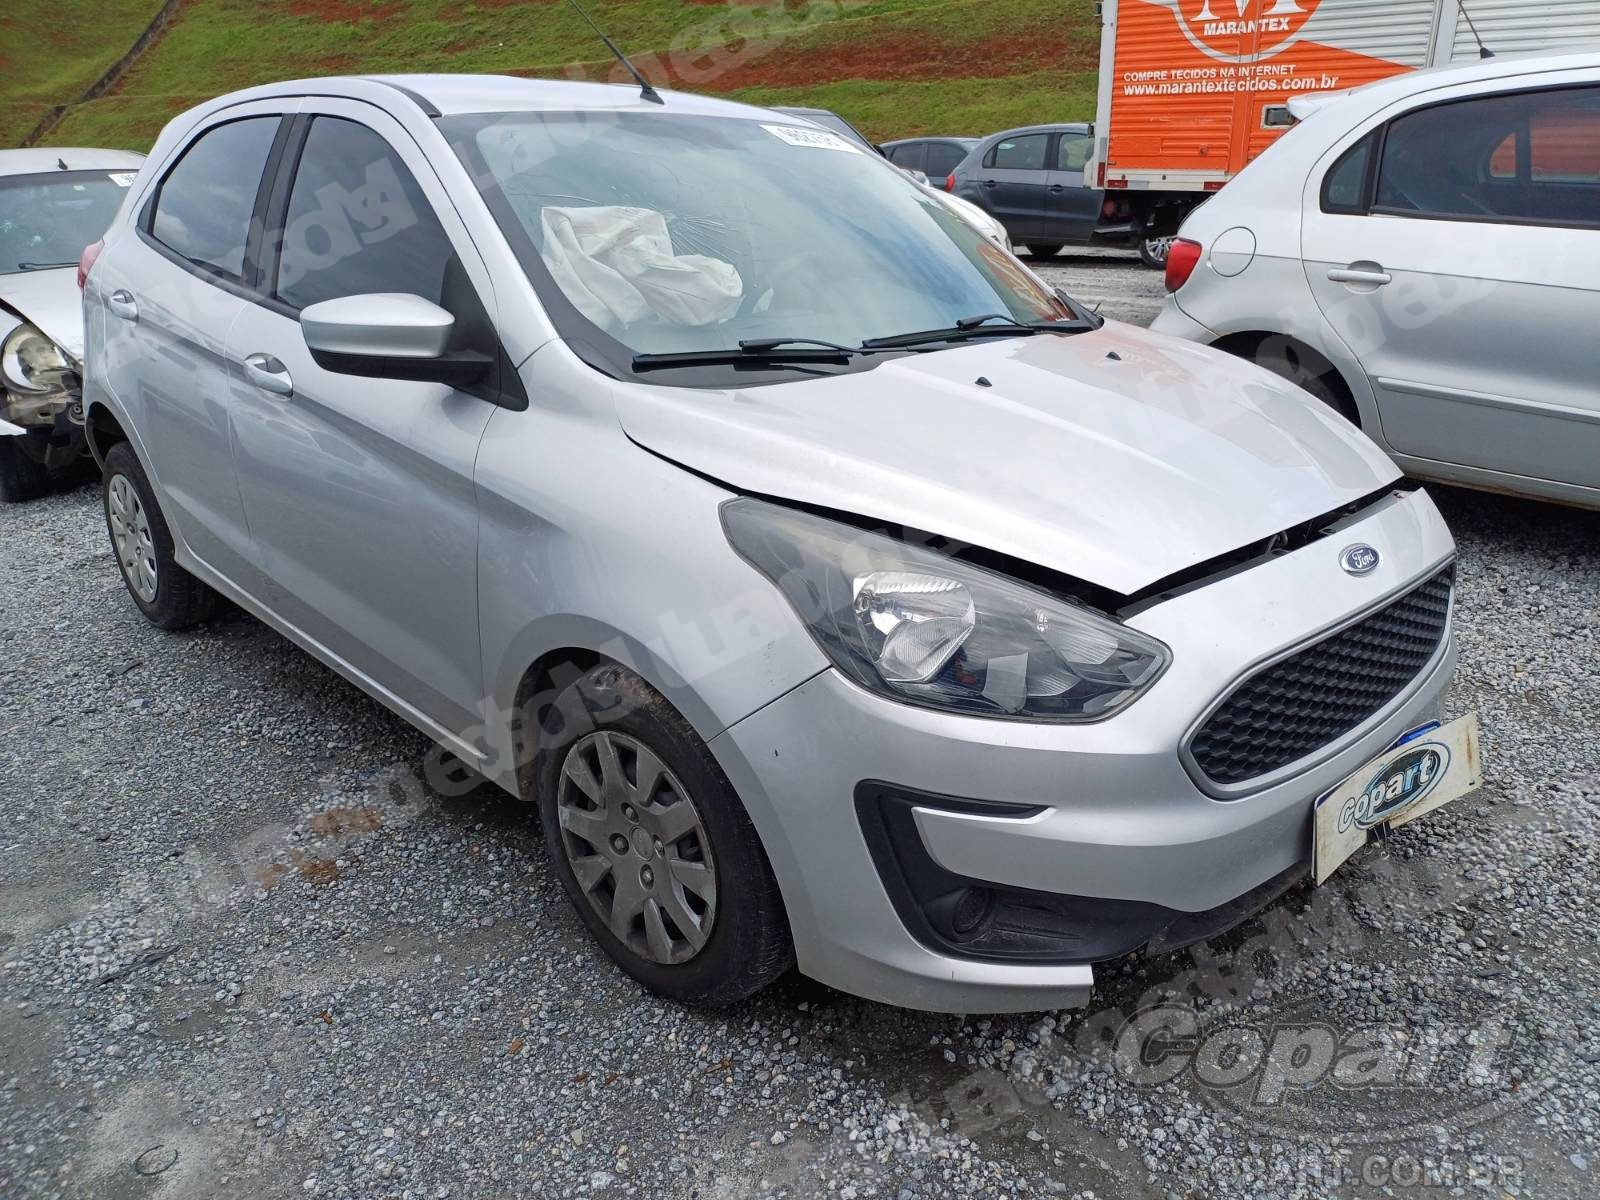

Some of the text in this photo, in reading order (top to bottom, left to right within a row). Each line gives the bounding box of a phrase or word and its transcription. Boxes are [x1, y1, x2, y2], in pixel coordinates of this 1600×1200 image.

[1203, 17, 1290, 36] MARANTEX
[1123, 64, 1296, 81] COMPRE TECIDOS NA INTERNET
[1123, 73, 1339, 96] www.marantextecidos.com.br
[1351, 549, 1376, 568] Ford
